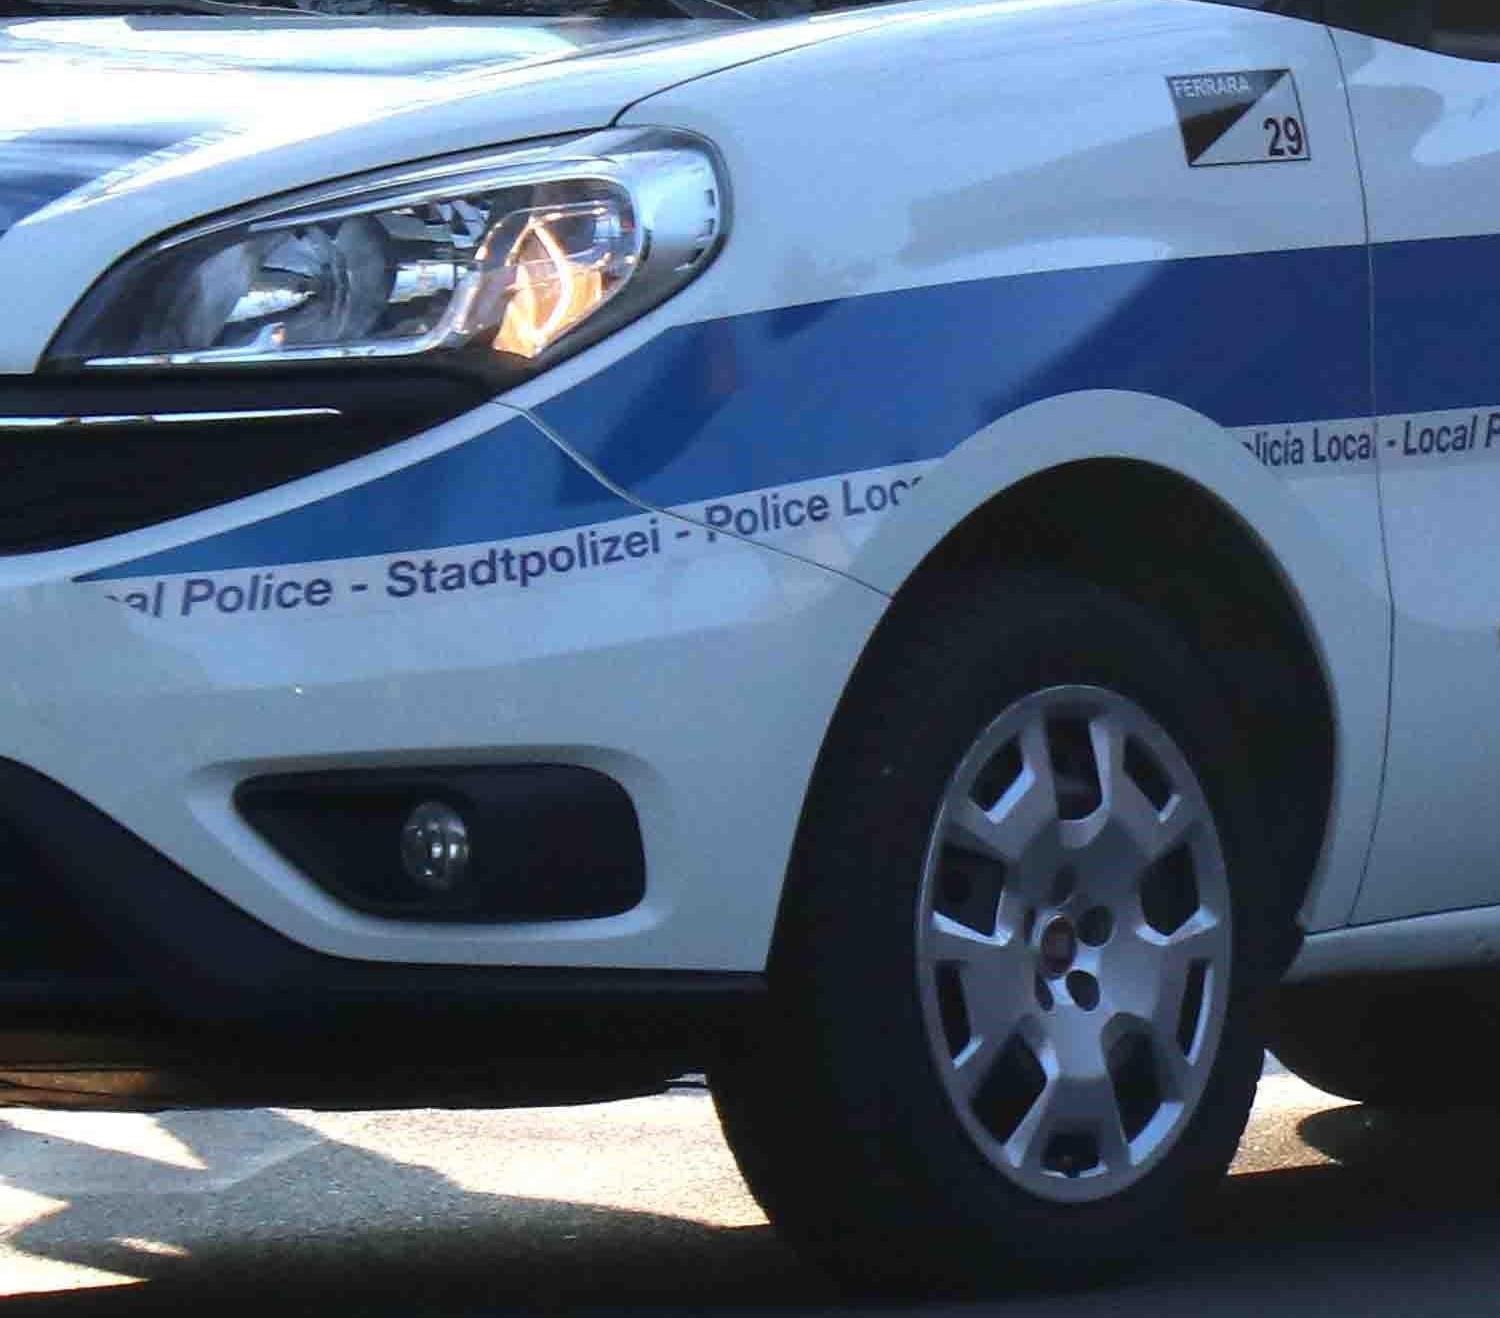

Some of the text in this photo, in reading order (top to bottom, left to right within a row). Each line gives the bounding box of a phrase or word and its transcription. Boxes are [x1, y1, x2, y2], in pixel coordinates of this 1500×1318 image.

[1173, 74, 1251, 98] FERRARA
[1264, 116, 1303, 156] 29
[1313, 428, 1376, 463] Local
[1403, 414, 1478, 456] Local
[104, 581, 165, 618] al
[180, 575, 332, 618] Police
[384, 519, 661, 599] Stadtpolizei
[705, 487, 830, 543] Police
[841, 475, 923, 517] Loc
